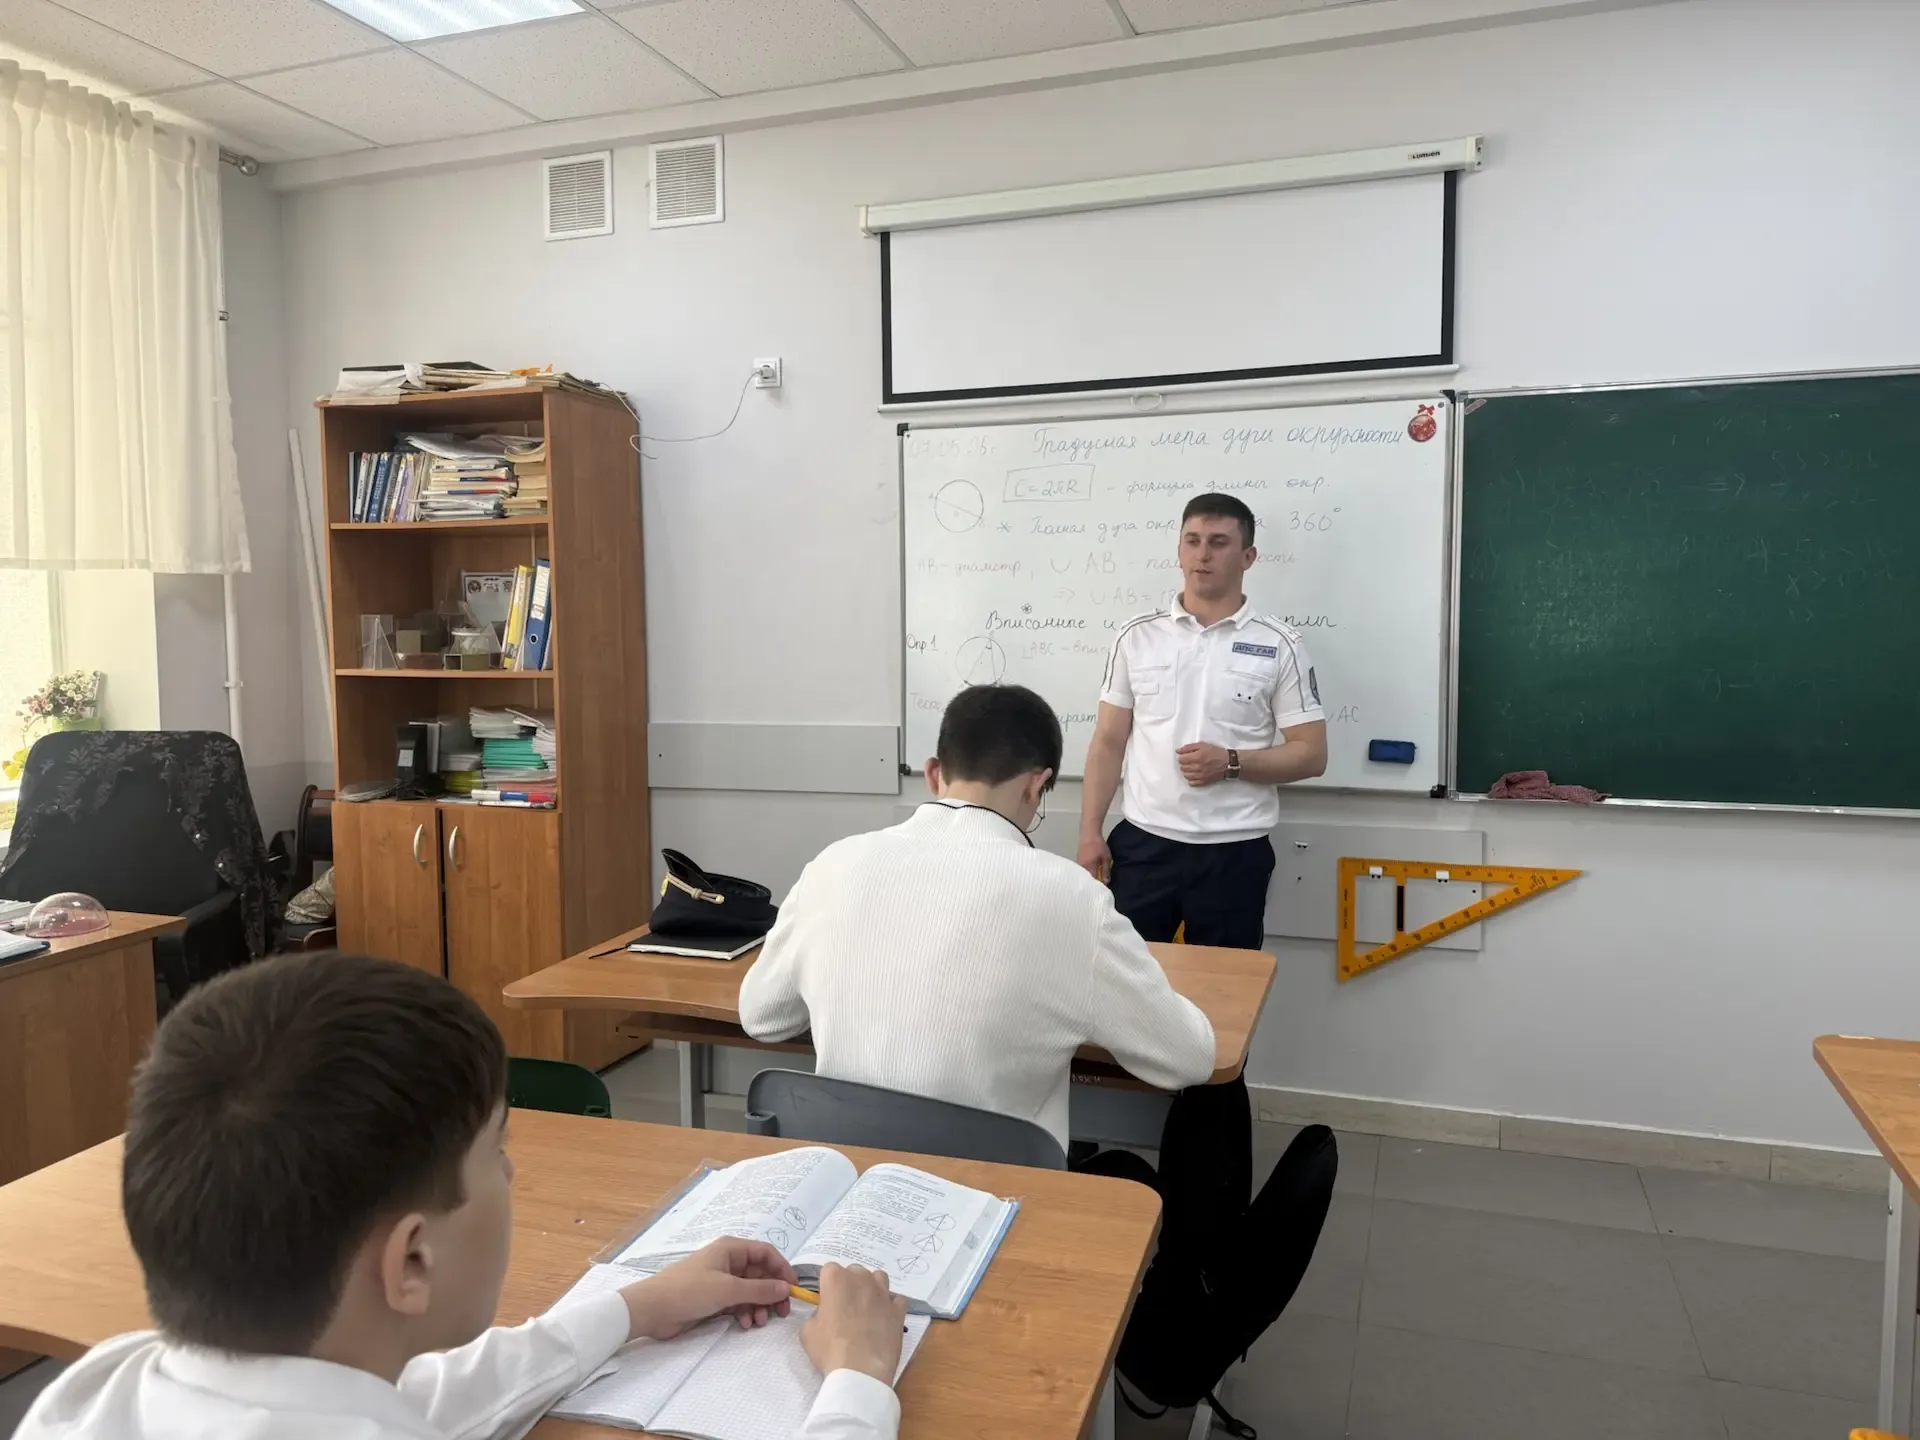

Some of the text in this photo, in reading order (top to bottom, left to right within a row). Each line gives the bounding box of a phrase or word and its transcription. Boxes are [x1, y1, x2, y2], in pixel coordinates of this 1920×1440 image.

[1034, 423, 1404, 462] Градусная мера дуги окружности
[985, 609, 1087, 631] Вписанные
[1235, 644, 1274, 656] ДПС ГАИ
